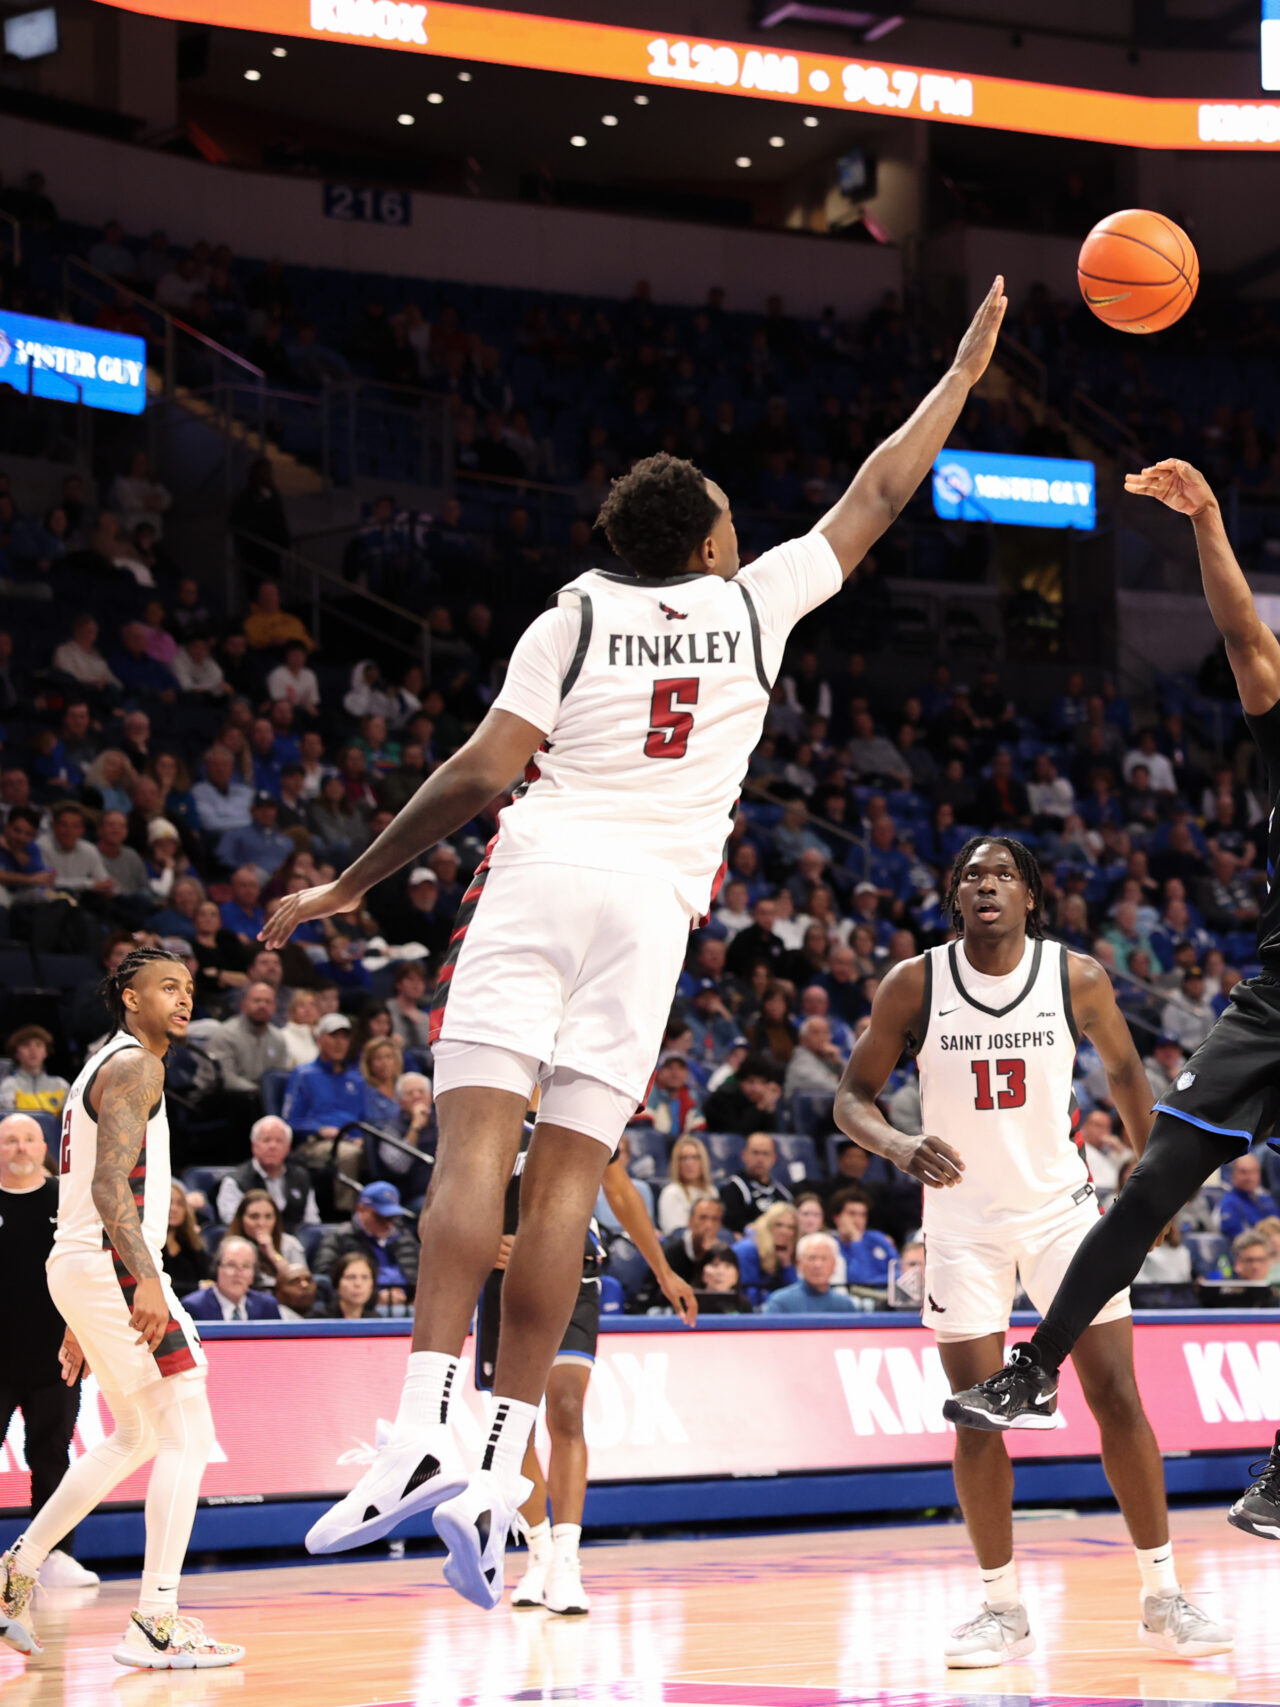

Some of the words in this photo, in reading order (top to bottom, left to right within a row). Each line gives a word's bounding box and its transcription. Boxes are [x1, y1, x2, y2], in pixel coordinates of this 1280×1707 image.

[331, 185, 403, 225] 216
[97, 355, 143, 387] GUY
[608, 631, 741, 667] FINKLEY
[643, 677, 700, 760] 5
[940, 1034, 982, 1050] SAINT
[987, 1030, 1055, 1050] JOSEPH'S
[971, 1058, 1027, 1110] 13
